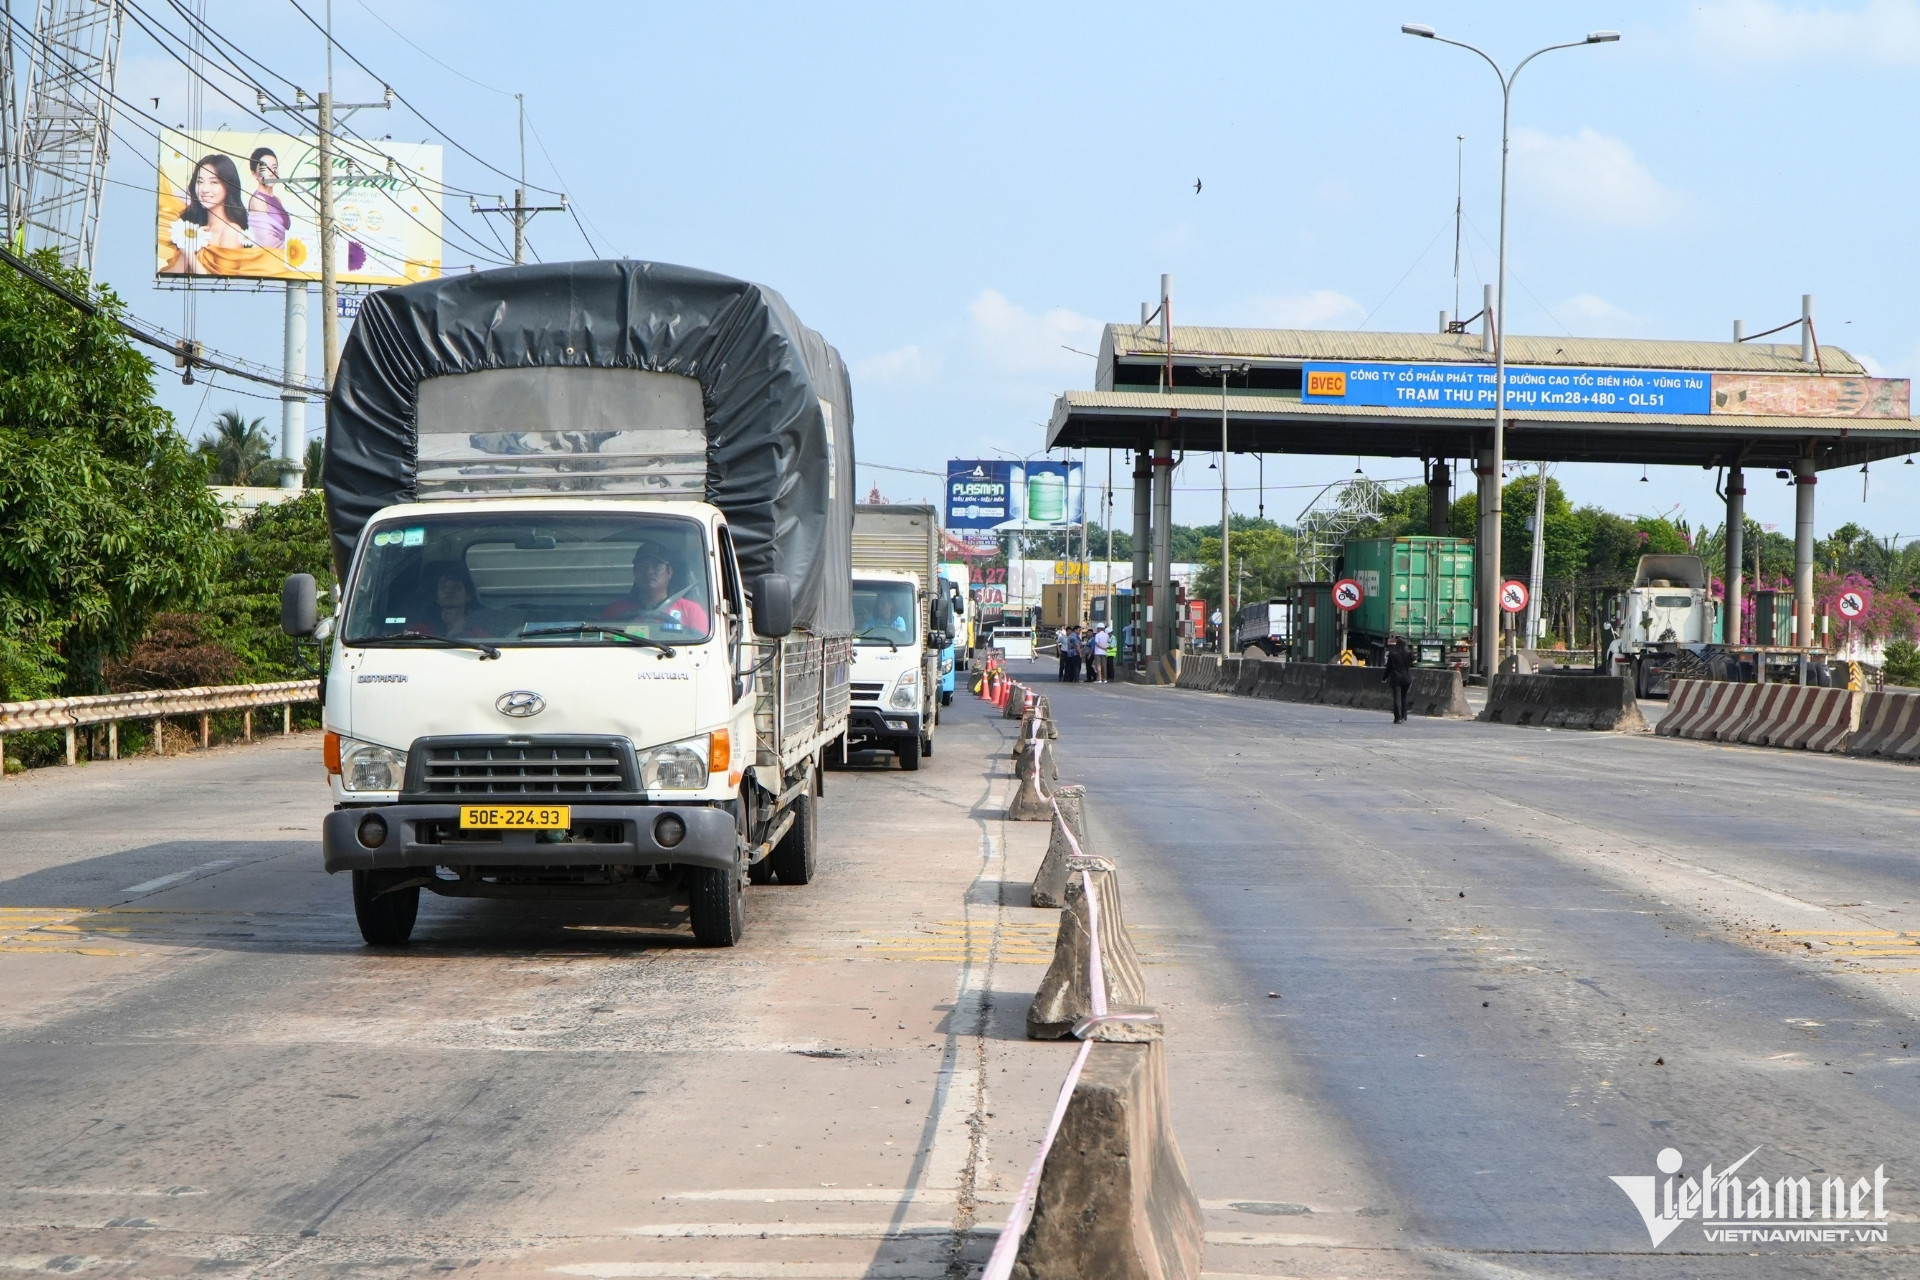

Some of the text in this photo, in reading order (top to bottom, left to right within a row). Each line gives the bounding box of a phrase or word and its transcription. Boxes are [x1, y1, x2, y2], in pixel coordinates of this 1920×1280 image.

[1311, 376, 1342, 391] BVEC
[1350, 370, 1379, 381] CÔNG
[1382, 371, 1395, 381] TY
[1399, 368, 1414, 382] CỔ
[1416, 369, 1443, 383] PHẦN
[1447, 371, 1473, 383] PHÁT
[1509, 373, 1546, 385] ĐƯỜNG
[1549, 375, 1570, 386] CAO
[1573, 373, 1594, 386] TỐC
[1597, 374, 1620, 387] BIÊN
[1622, 374, 1644, 388] HÒA
[1653, 376, 1681, 389] VŨNG
[1684, 375, 1703, 389] TÀU
[1396, 387, 1439, 402] TRẠM
[1444, 389, 1474, 402] THU
[1478, 389, 1499, 402] PH
[1506, 391, 1536, 406] PHỤ
[1541, 391, 1616, 405] Km28+480
[1628, 394, 1664, 406] QL51
[952, 483, 1005, 496] PLASMAN
[986, 567, 1006, 583] 27
[638, 671, 689, 680] HYUNDAI
